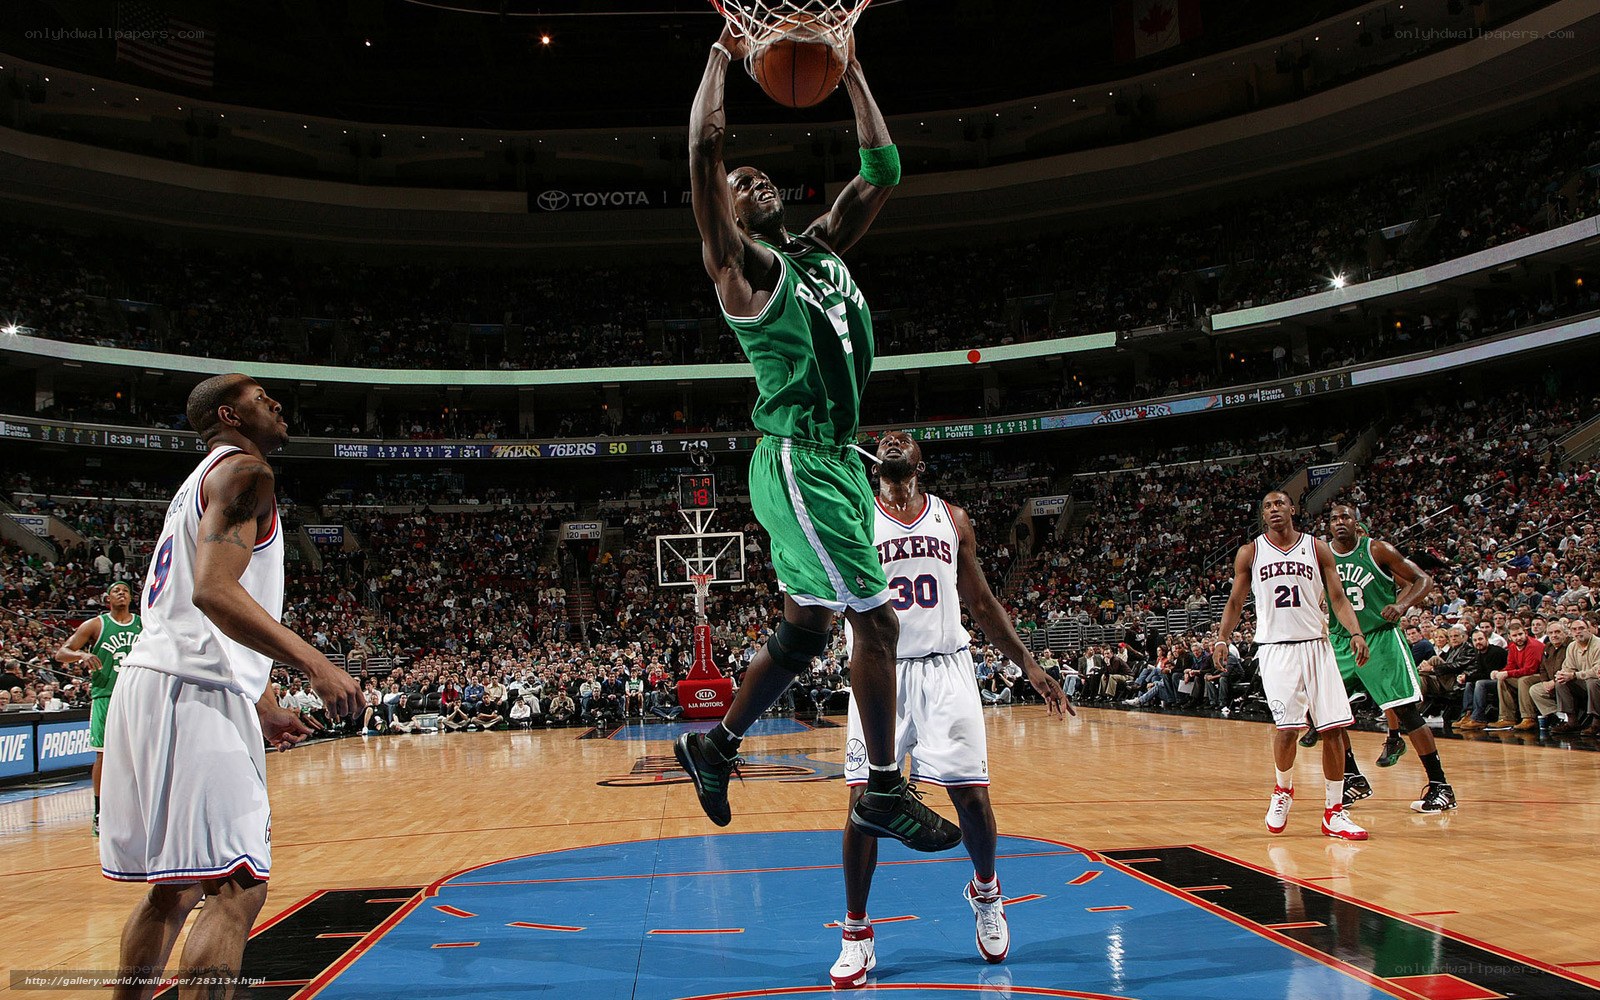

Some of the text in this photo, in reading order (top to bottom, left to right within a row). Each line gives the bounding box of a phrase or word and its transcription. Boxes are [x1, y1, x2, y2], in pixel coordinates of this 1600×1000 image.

[572, 191, 649, 206] TOYOTA
[1261, 387, 1282, 396] Sixers
[1261, 392, 1285, 401] Celtics
[1225, 393, 1246, 405] 8:39
[944, 424, 974, 433] PLAYER
[5, 430, 32, 438] Celtics
[923, 430, 931, 440] 4
[934, 430, 941, 440] 1
[945, 430, 974, 439] POINTS
[110, 434, 132, 445] 8:39
[548, 443, 628, 457] 76ERS 50
[650, 444, 663, 453] 18
[728, 441, 736, 450] 3
[444, 450, 452, 458] 2
[463, 449, 471, 458] 3
[475, 449, 481, 458] 1
[690, 477, 710, 487] 7:19
[1310, 477, 1321, 486] 117
[693, 489, 708, 506] 18
[1036, 498, 1065, 506] GEICO
[1034, 507, 1045, 515] 118
[148, 534, 174, 610] 9
[1259, 561, 1313, 582] SIXERS
[888, 573, 938, 611] 30
[1274, 585, 1301, 608] 21
[1343, 586, 1365, 611] 3
[101, 631, 140, 654] BOSTO
[113, 652, 129, 673] 3
[41, 729, 91, 760] PROGRE
